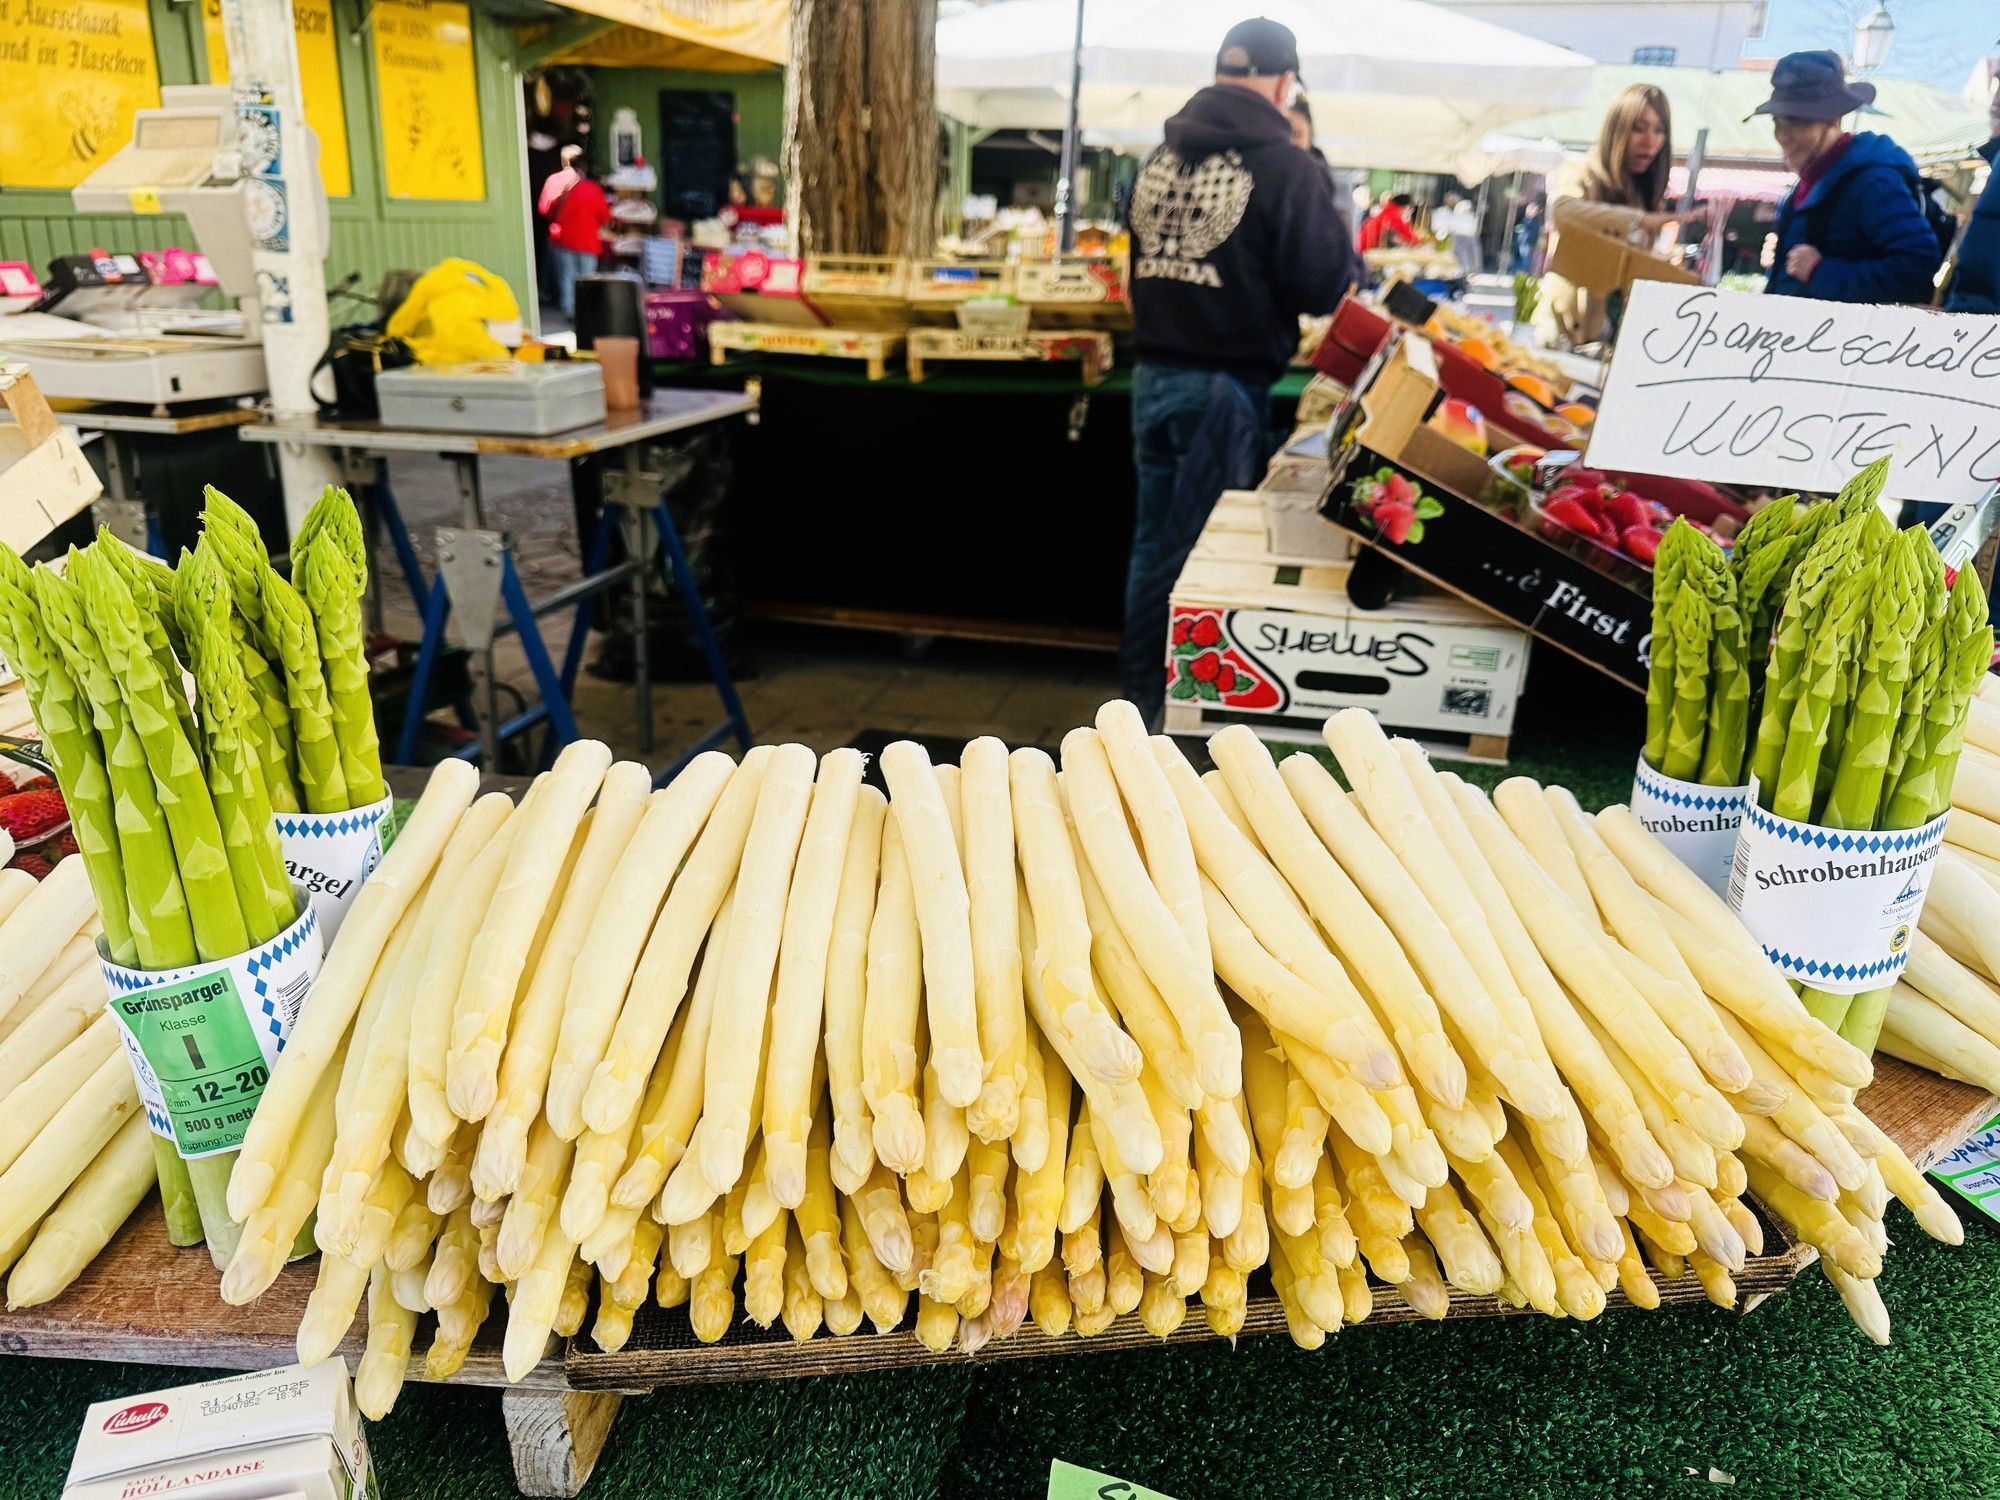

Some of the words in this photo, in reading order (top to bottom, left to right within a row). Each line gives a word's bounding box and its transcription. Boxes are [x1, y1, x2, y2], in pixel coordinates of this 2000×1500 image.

[1542, 578, 1633, 645] First
[1255, 623, 1435, 677] Samaris
[122, 976, 229, 1015] Grünspargel
[159, 1014, 207, 1032] Klasse
[181, 1033, 207, 1071] I
[185, 1118, 211, 1133] 500
[215, 1115, 225, 1130] g
[226, 1107, 256, 1124] nett
[121, 1459, 265, 1500] HOLLANDAISE
